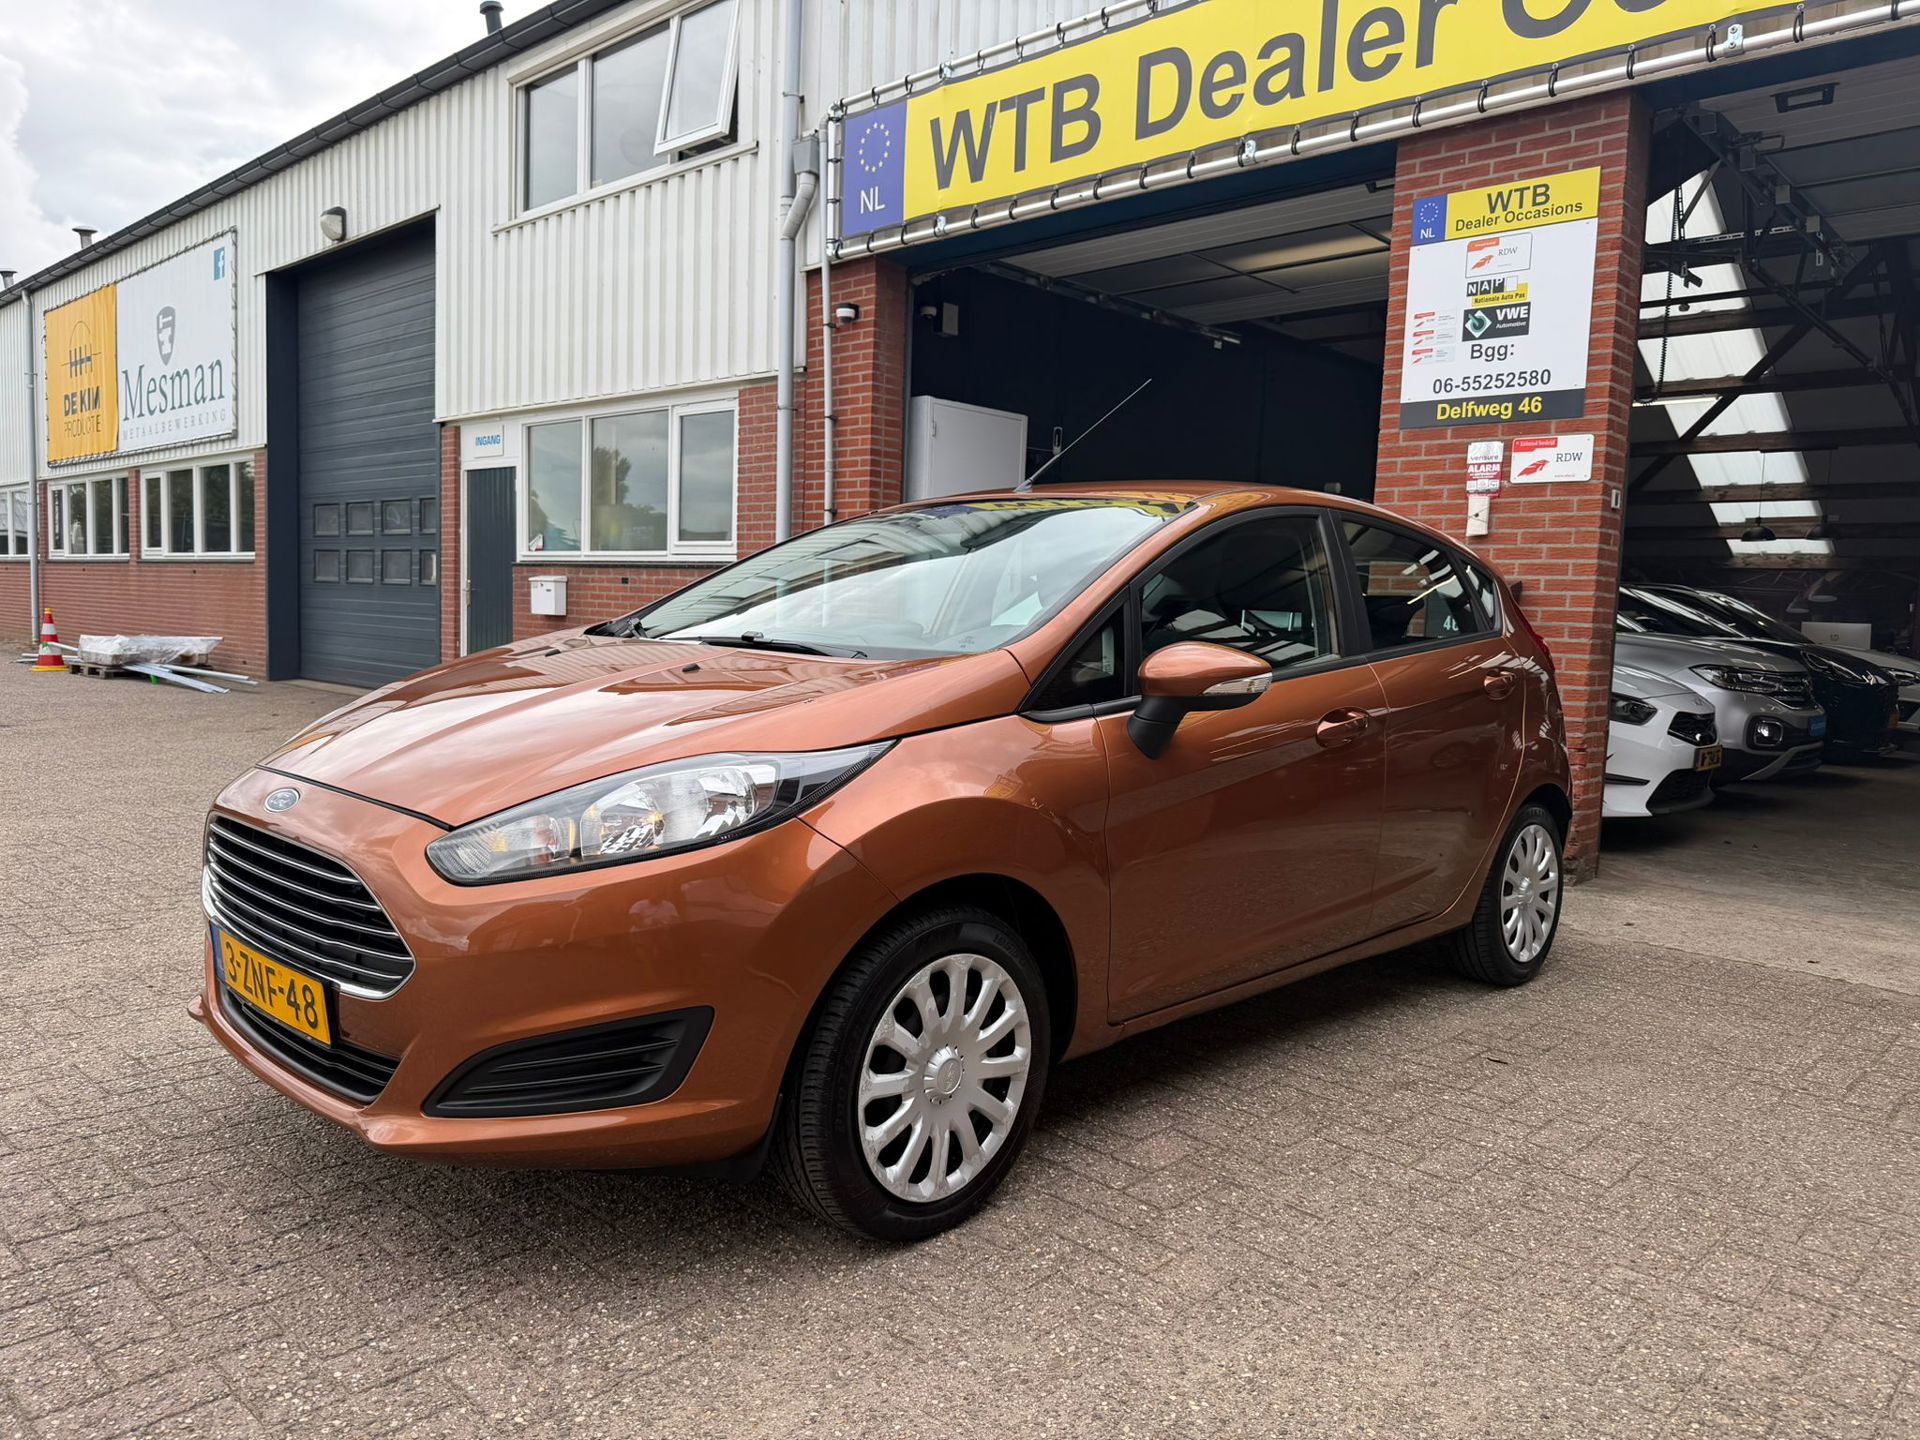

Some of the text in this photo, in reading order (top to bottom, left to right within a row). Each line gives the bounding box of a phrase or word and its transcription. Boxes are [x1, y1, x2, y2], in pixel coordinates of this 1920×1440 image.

[930, 0, 1459, 191] WTB Dealer
[859, 186, 885, 215] NL
[1487, 183, 1551, 214] WTB
[1455, 201, 1583, 232] Dealer Occasions
[1420, 227, 1436, 239] NL
[1498, 246, 1519, 256] RDW
[1467, 278, 1505, 295] NAP
[1496, 305, 1529, 321] VWE
[1470, 343, 1515, 363] Bgg:
[121, 358, 225, 421] Mesman
[1432, 368, 1551, 394] 06-55252580
[63, 392, 78, 417] DE
[1436, 396, 1544, 420] Delfweg 46
[475, 434, 501, 446] INGANG
[1467, 463, 1501, 473] ALARM
[1555, 451, 1583, 463] RDW
[225, 941, 319, 1030] 3-ZNF-48
